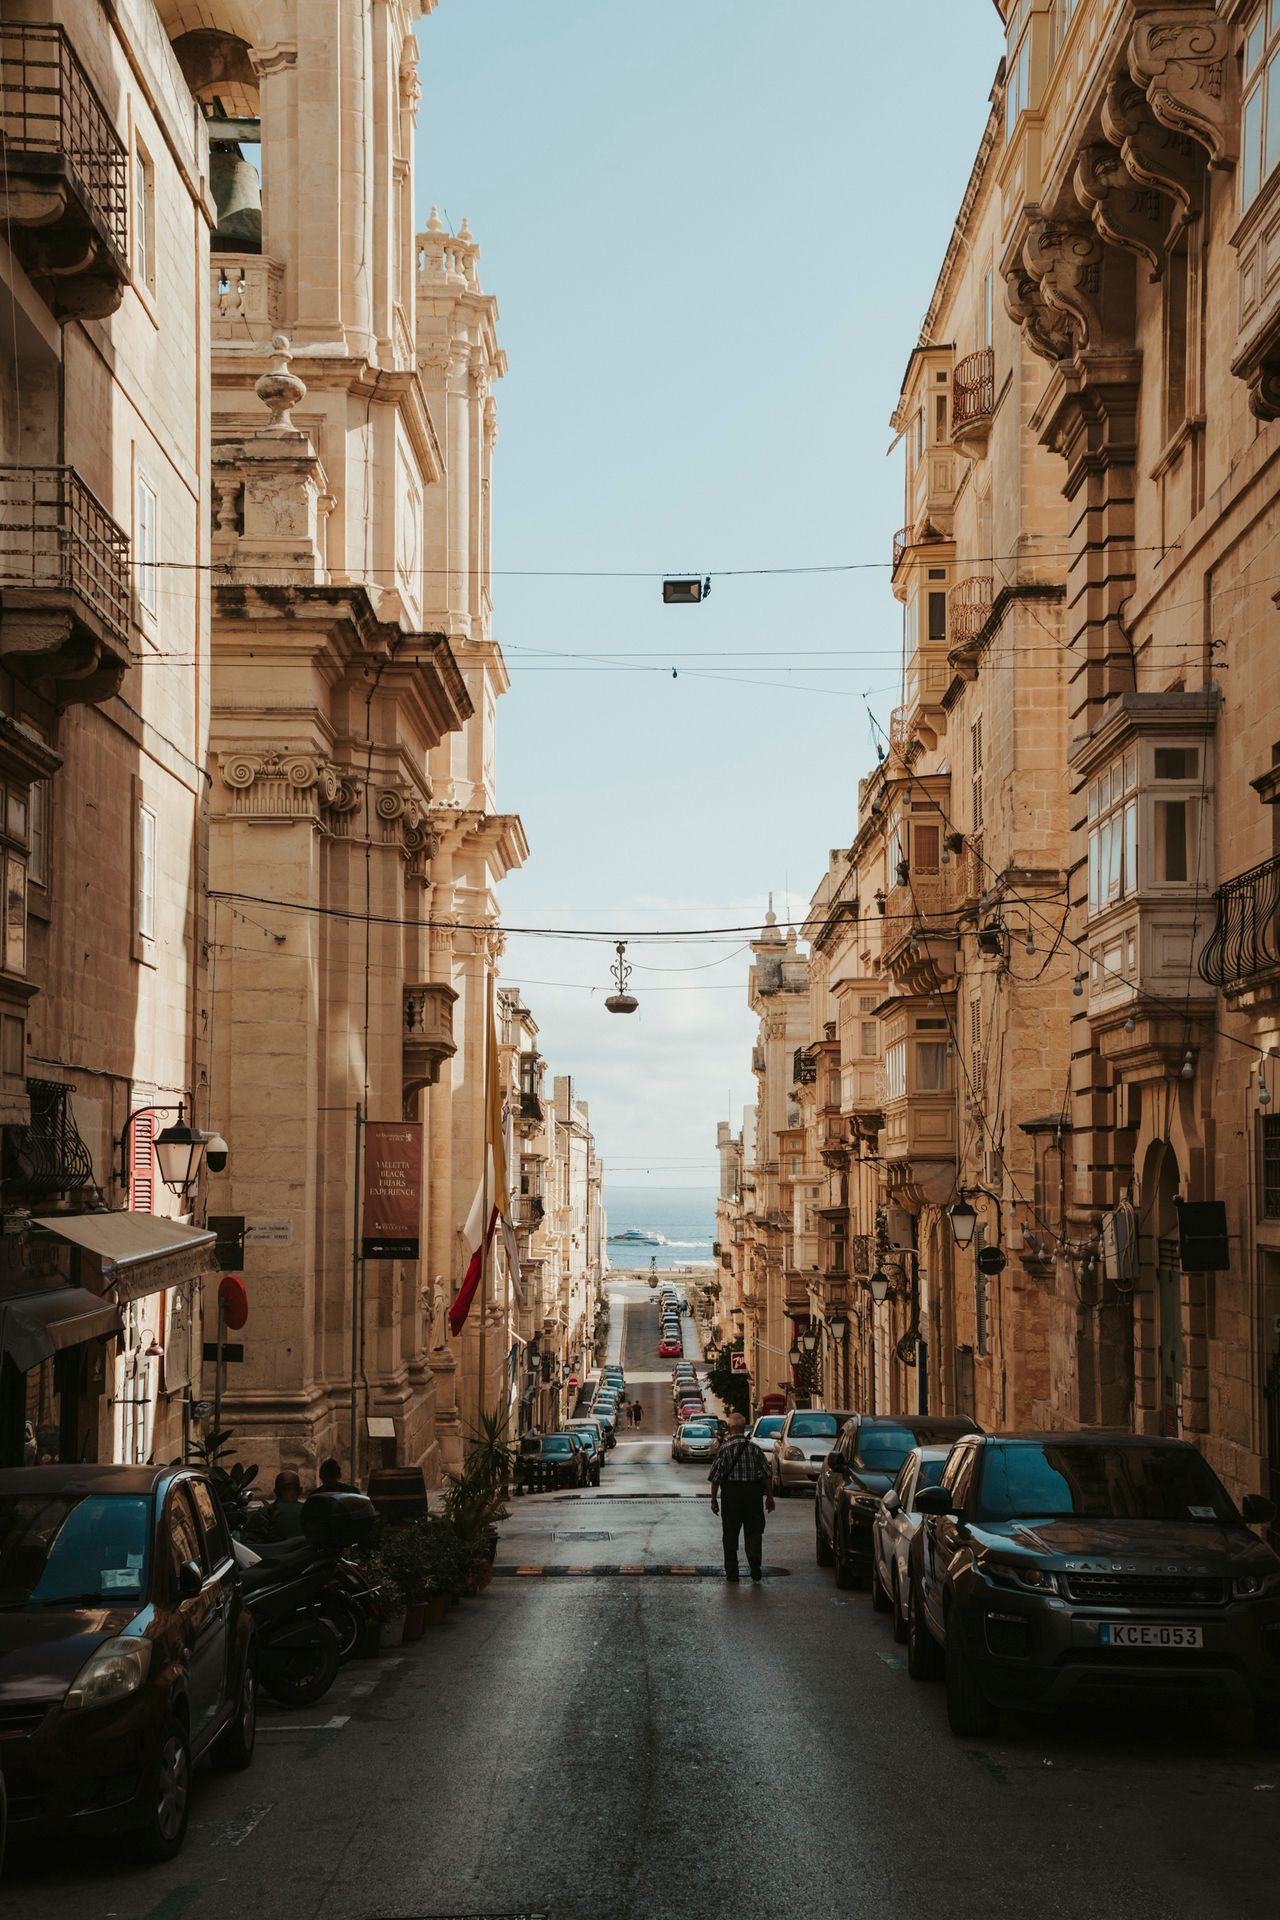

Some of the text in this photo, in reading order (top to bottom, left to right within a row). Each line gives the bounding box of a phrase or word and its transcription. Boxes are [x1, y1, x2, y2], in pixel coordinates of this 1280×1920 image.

[376, 1160, 410, 1169] VALLETTA
[380, 1170, 406, 1178] BLACK
[379, 1179, 406, 1187] FRIARS
[369, 1188, 415, 1196] EXPERIENCE
[1065, 1561, 1137, 1571] RANGE
